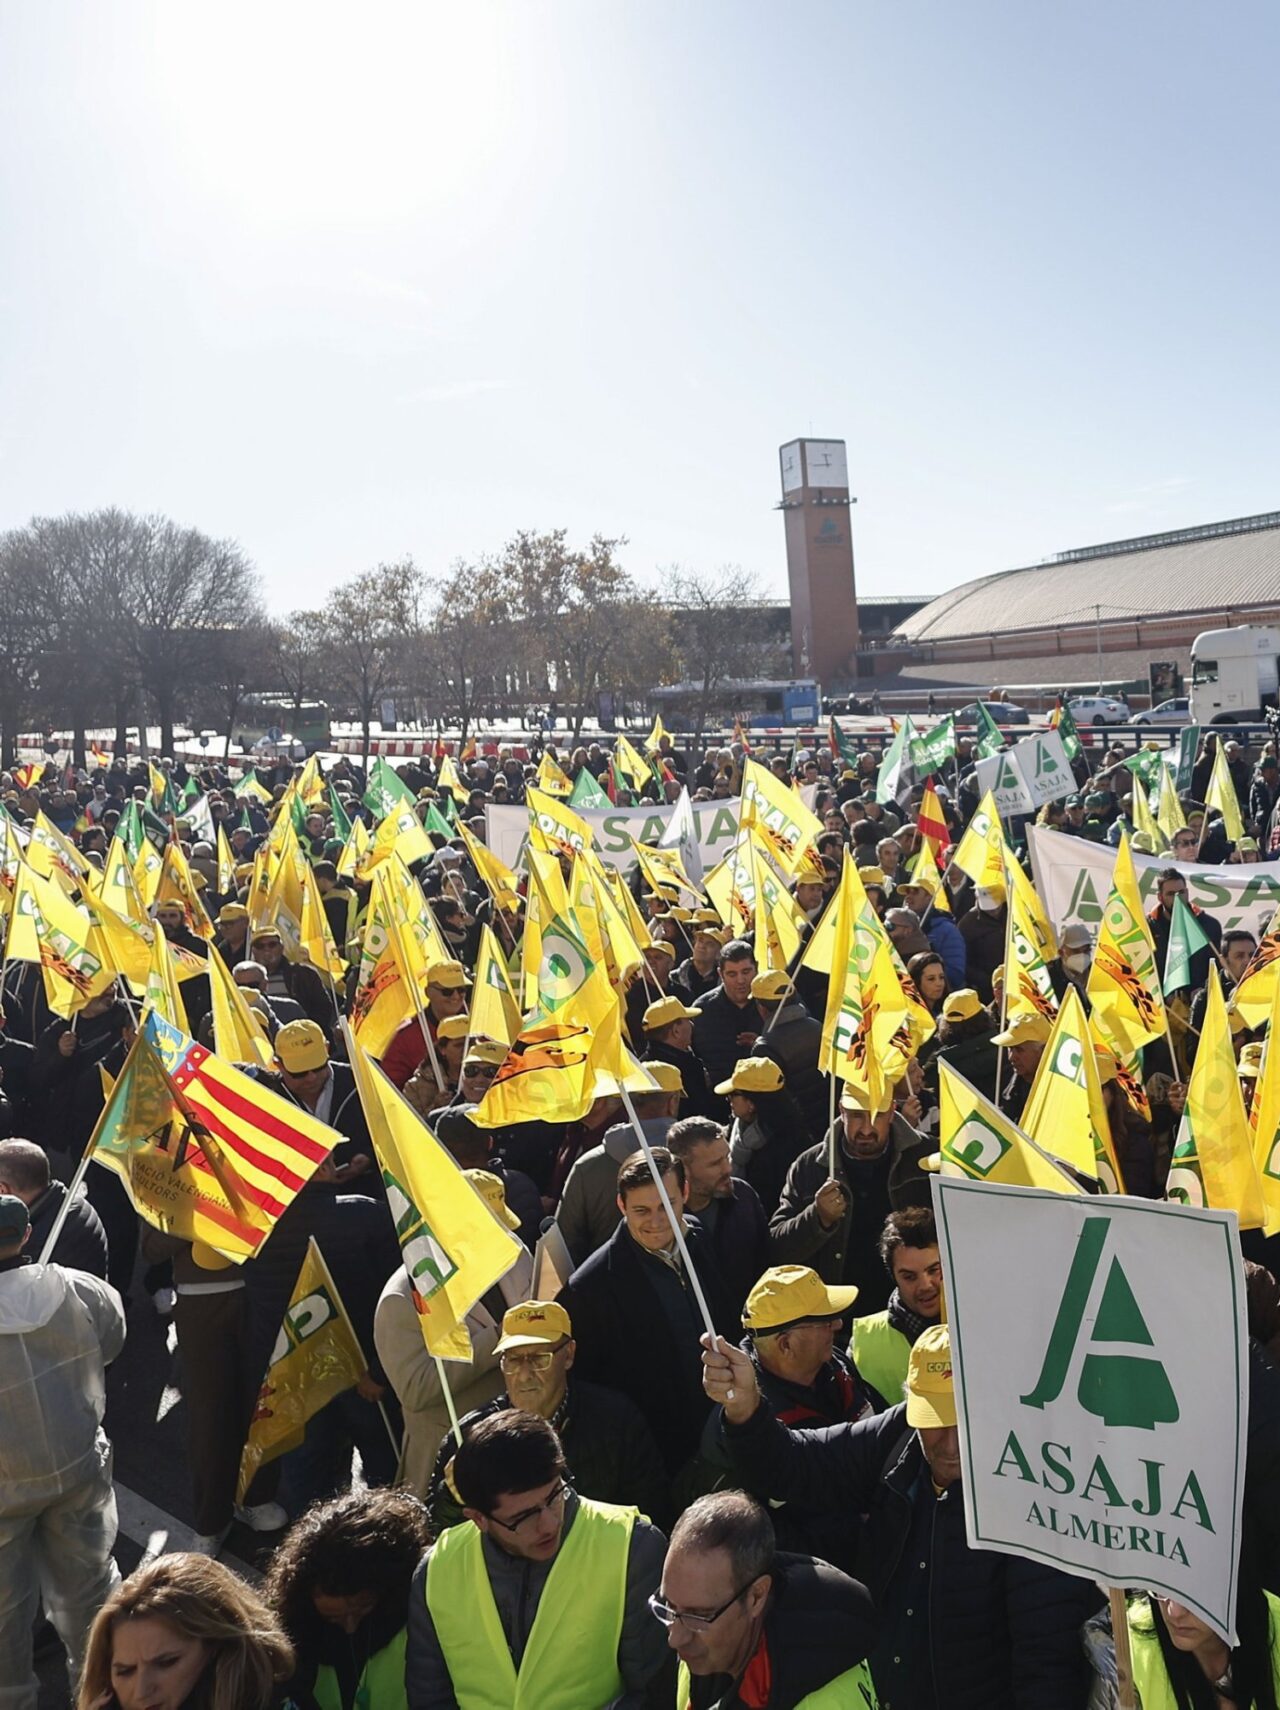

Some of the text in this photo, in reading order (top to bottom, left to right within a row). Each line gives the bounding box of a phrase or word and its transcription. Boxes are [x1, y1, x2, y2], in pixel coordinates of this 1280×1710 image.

[996, 791, 1026, 804] SAJA
[927, 1362, 953, 1373] COA
[991, 1429, 1217, 1535] ASAJA
[1025, 1500, 1192, 1568] ALMERIA
